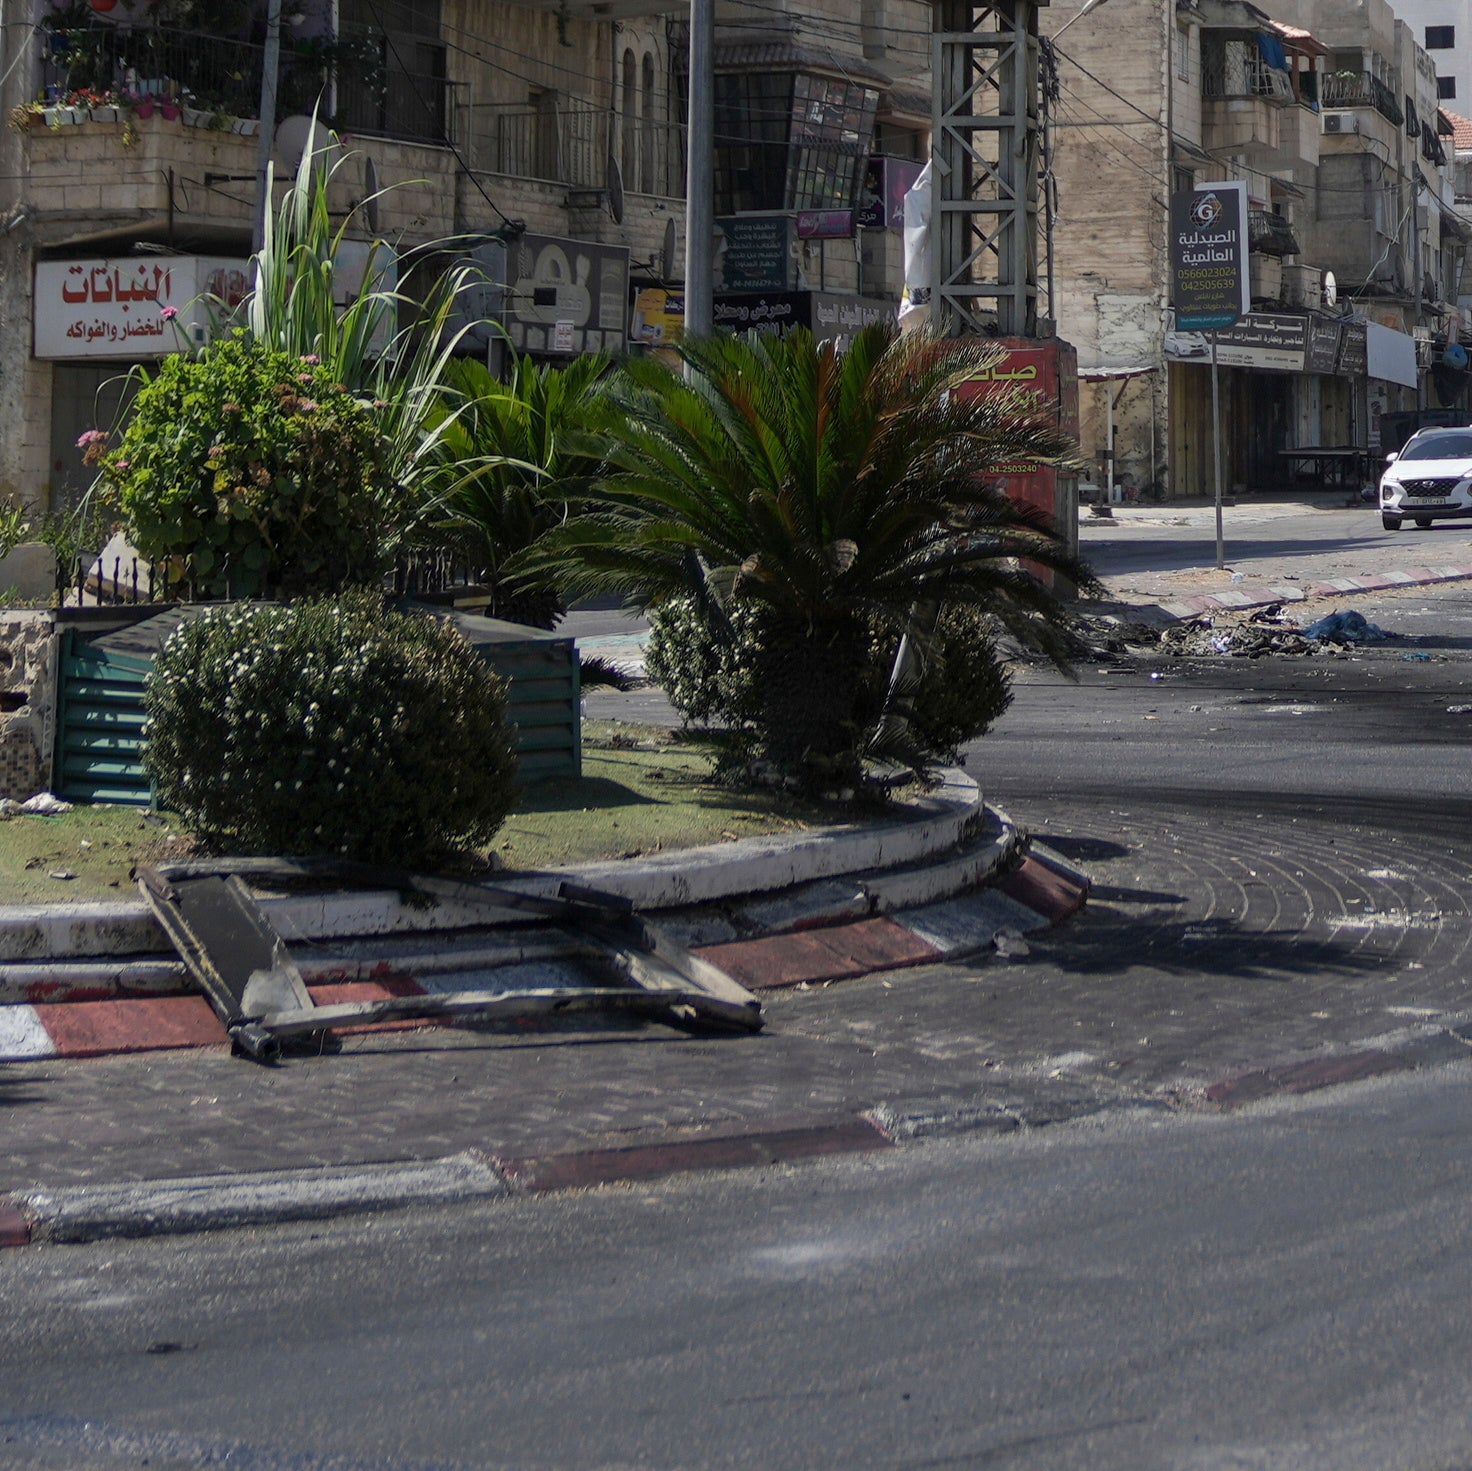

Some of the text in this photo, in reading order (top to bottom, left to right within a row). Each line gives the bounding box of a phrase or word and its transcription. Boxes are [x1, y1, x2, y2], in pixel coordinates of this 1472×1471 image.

[1178, 229, 1236, 248] الصيدلية
[1182, 248, 1234, 266] العالمية
[1177, 267, 1237, 279] 0566023024
[62, 264, 172, 312] النباتات
[1181, 279, 1235, 291] 042505639
[714, 299, 792, 321] معرض ومحلا
[118, 320, 166, 342] للخضار
[1234, 331, 1262, 343] السيارات
